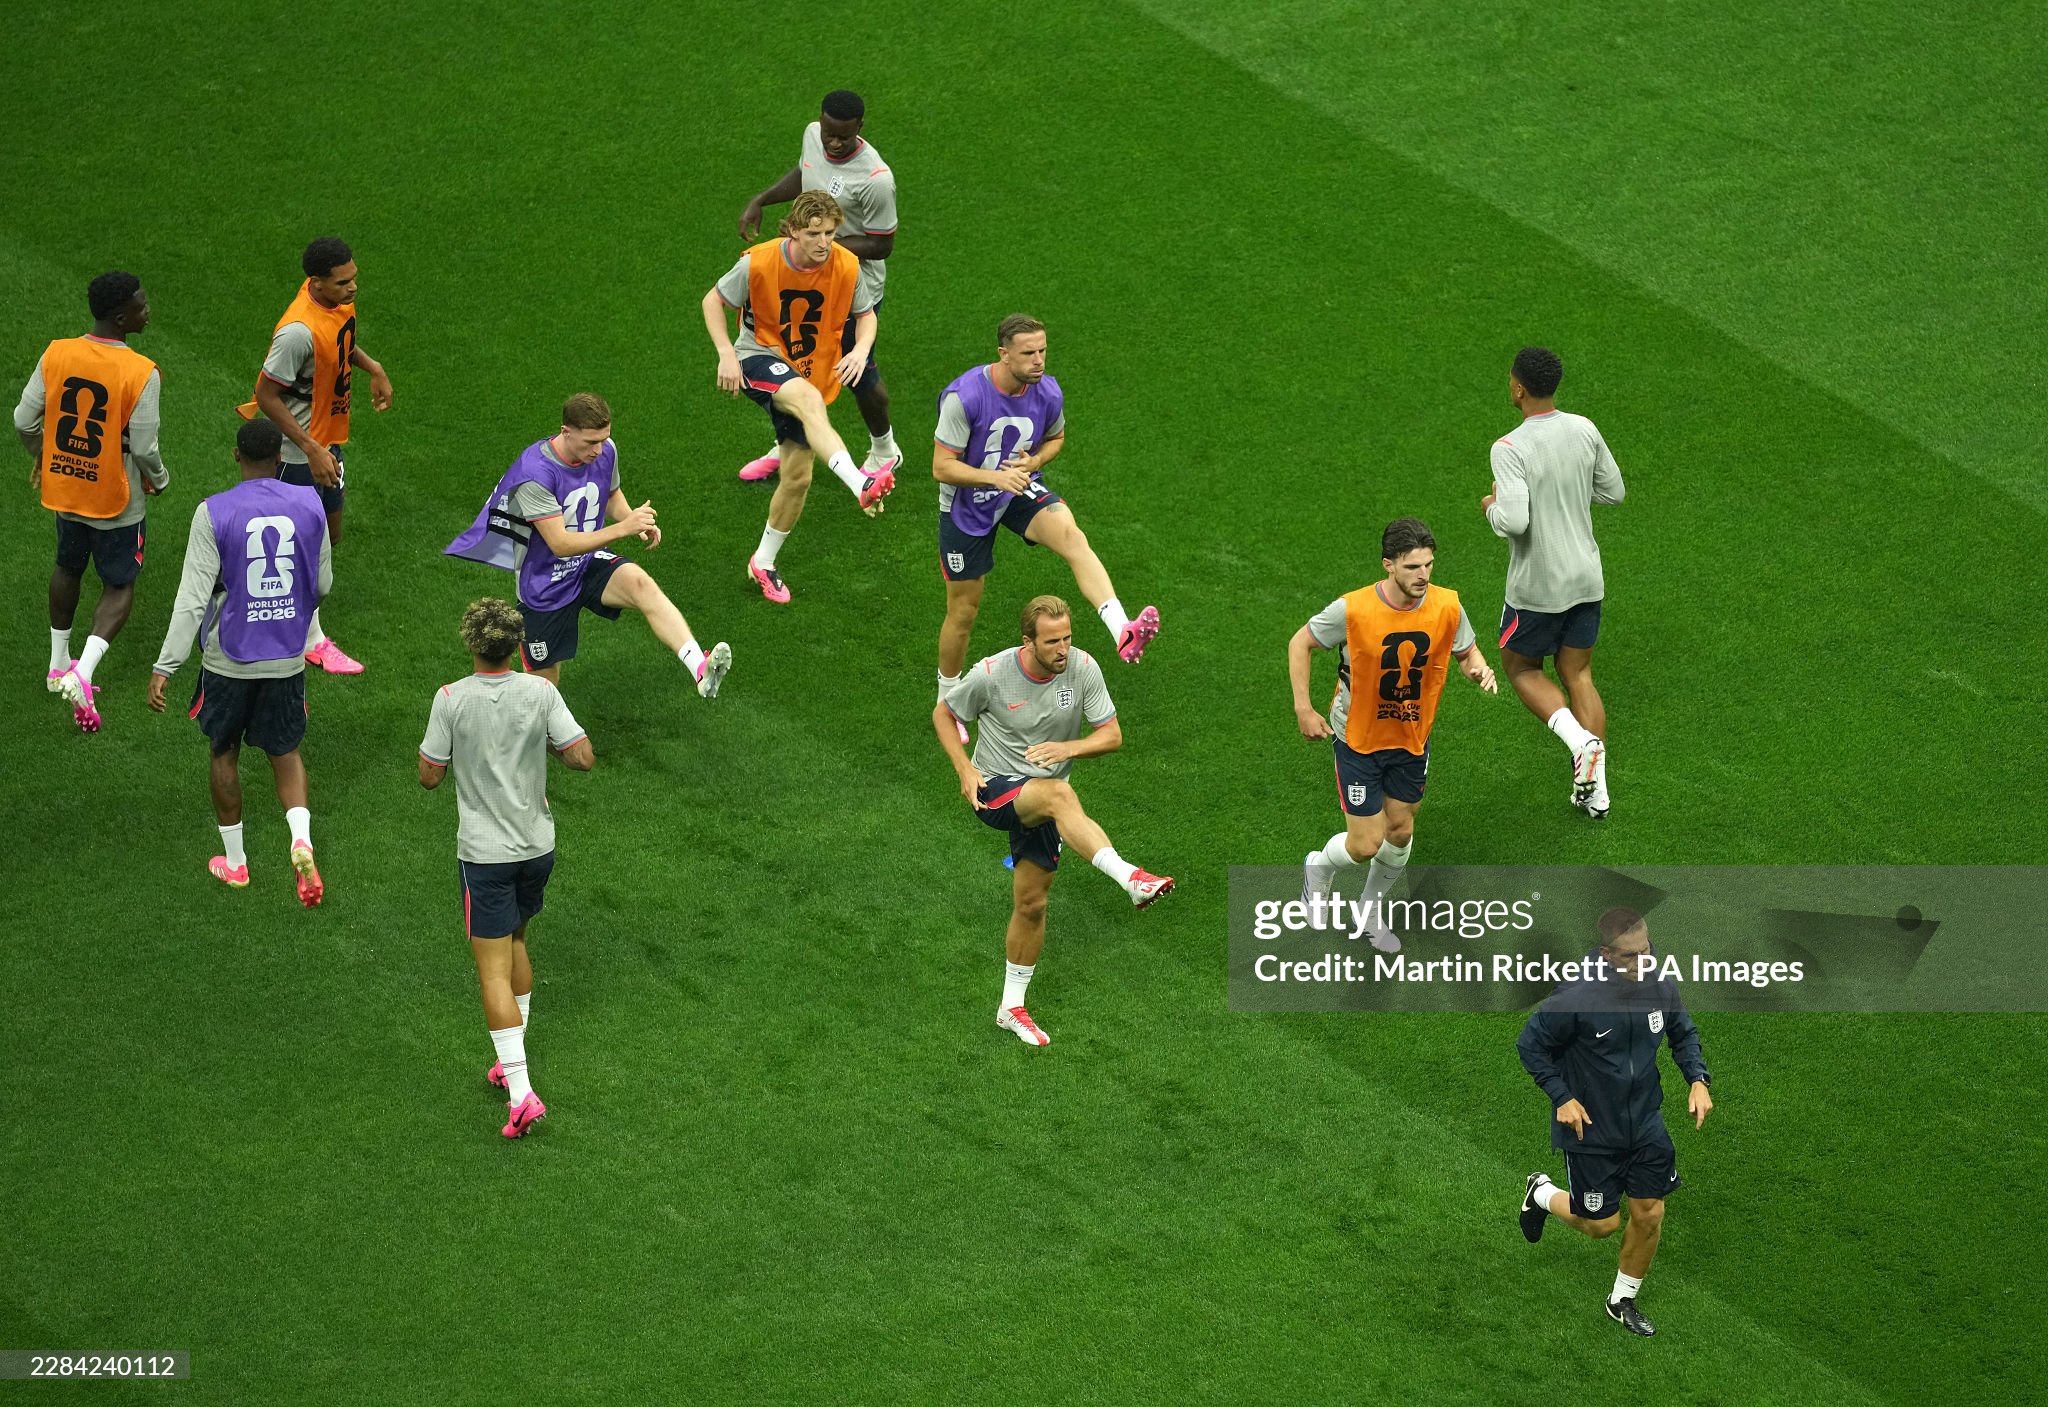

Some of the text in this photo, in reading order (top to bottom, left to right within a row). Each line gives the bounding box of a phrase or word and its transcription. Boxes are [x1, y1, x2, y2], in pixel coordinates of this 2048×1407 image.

[67, 438, 89, 451] FIFA
[52, 453, 99, 470] WORLD CUP
[49, 462, 98, 482] 2026
[1023, 481, 1049, 500] 14
[260, 580, 283, 591] FIFA
[247, 597, 294, 610] WORLD CUP
[246, 606, 296, 622] 2026
